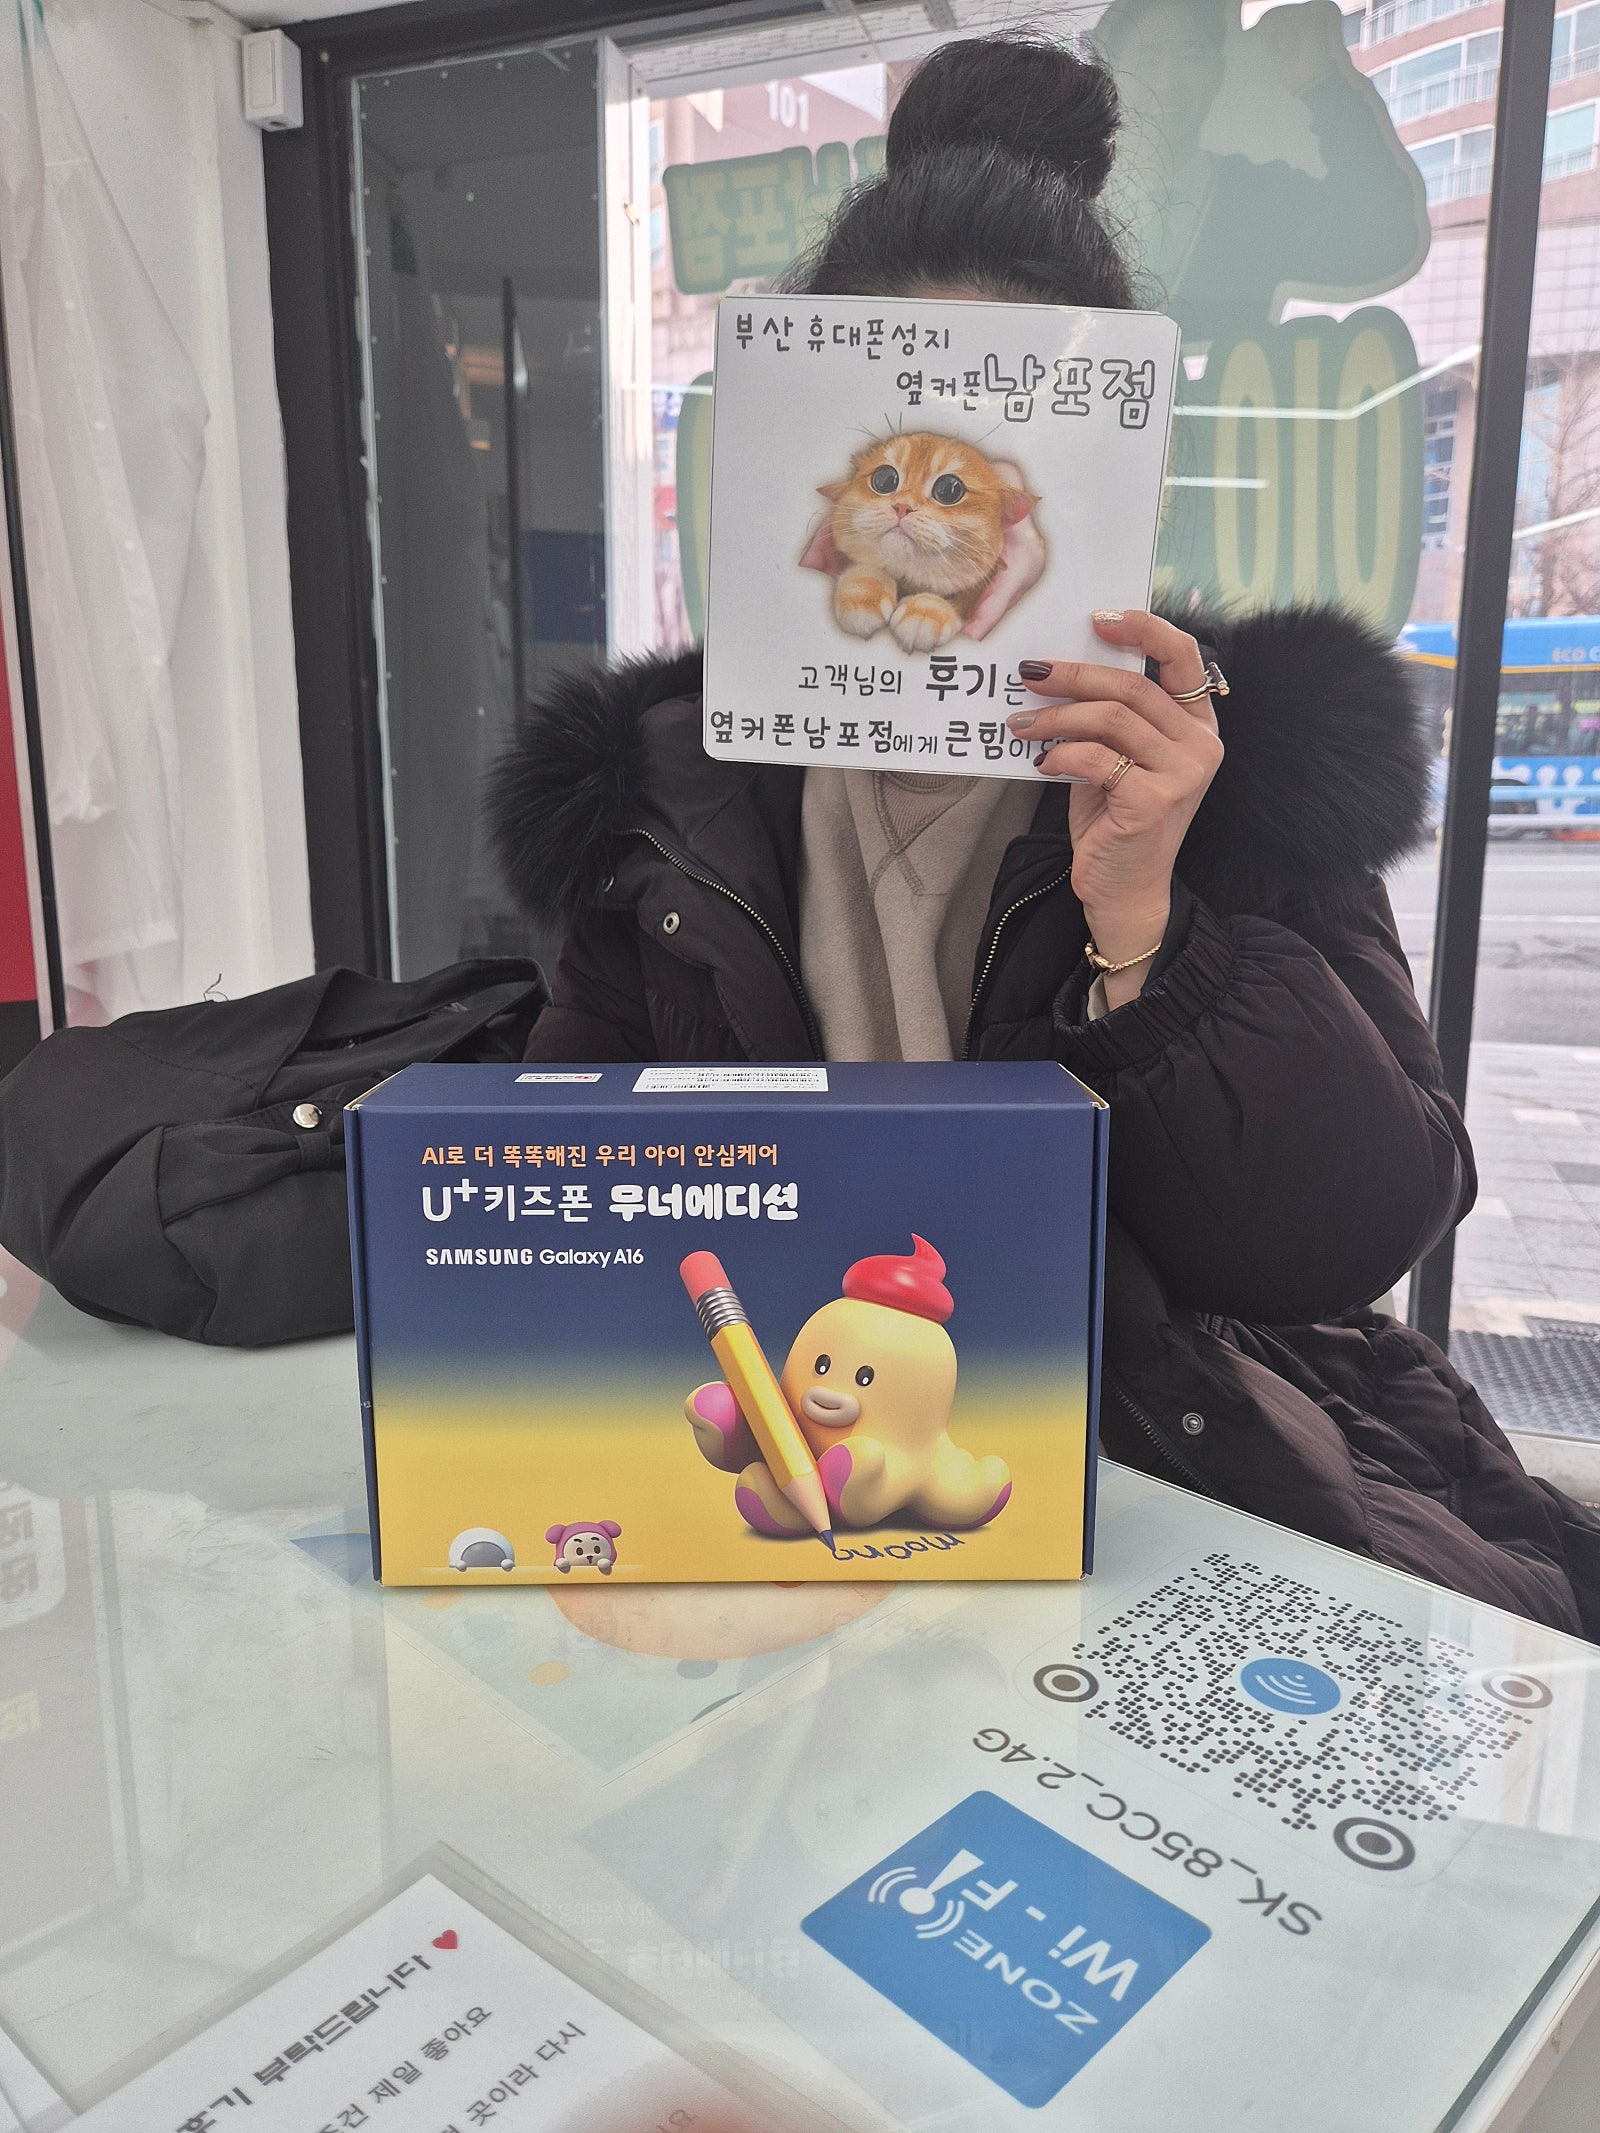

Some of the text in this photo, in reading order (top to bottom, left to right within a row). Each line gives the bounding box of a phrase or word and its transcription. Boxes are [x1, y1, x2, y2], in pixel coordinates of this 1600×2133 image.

[765, 79, 810, 134] 101
[735, 314, 951, 360] 부산 휴대폰성지
[798, 664, 902, 696] 고객님의
[421, 1144, 779, 1168] AI로 더 똑똑해진 우리 아이 안심케어
[608, 1181, 800, 1222] 무너에디션
[426, 1247, 645, 1269] SAMSUNG Galaxy A16
[971, 1726, 1325, 1937] SK_85CC_2.4G
[953, 1928, 1100, 2036] ZONE
[252, 1953, 433, 2087] 부탁드립니다
[367, 2060, 423, 2104] 제일
[420, 2005, 493, 2062] 좋아요
[466, 2020, 587, 2127] 곳이라 다시
